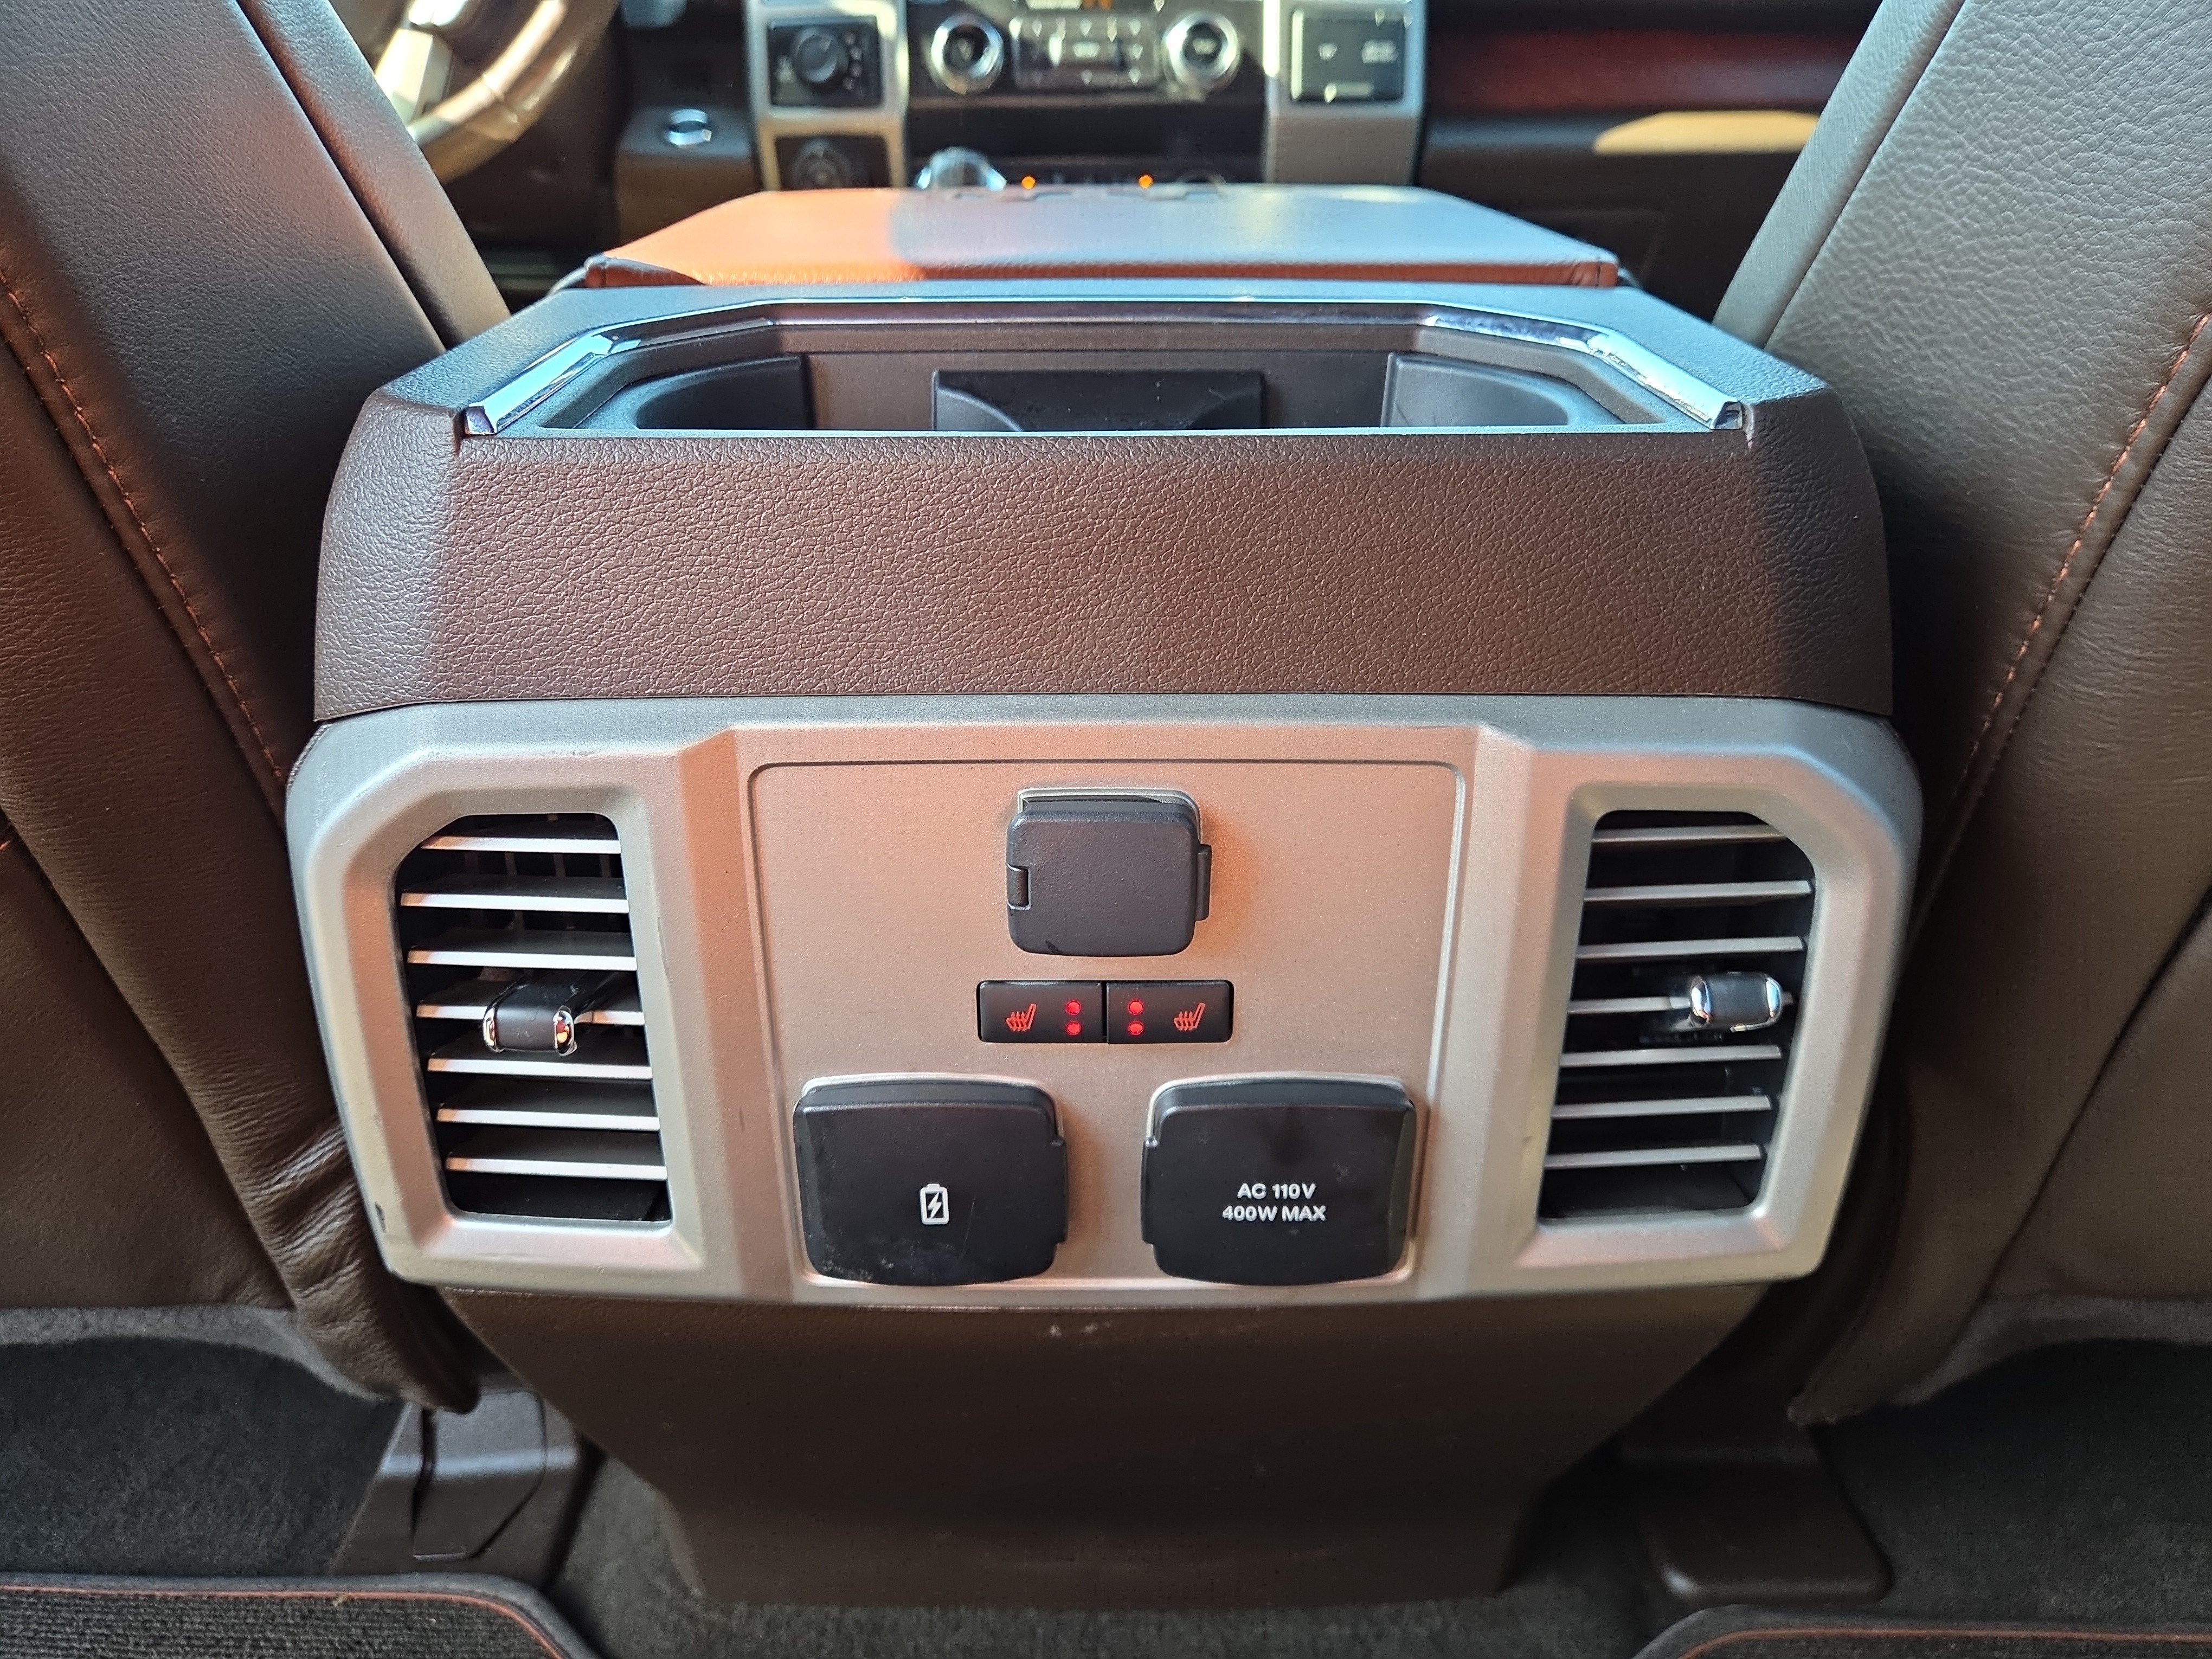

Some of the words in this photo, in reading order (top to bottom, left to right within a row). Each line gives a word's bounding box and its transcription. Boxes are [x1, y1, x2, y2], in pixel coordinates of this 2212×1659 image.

[1237, 1182, 1266, 1199] AC
[1272, 1182, 1316, 1199] 110V
[1222, 1205, 1278, 1221] 400W
[1282, 1205, 1327, 1221] MAX
